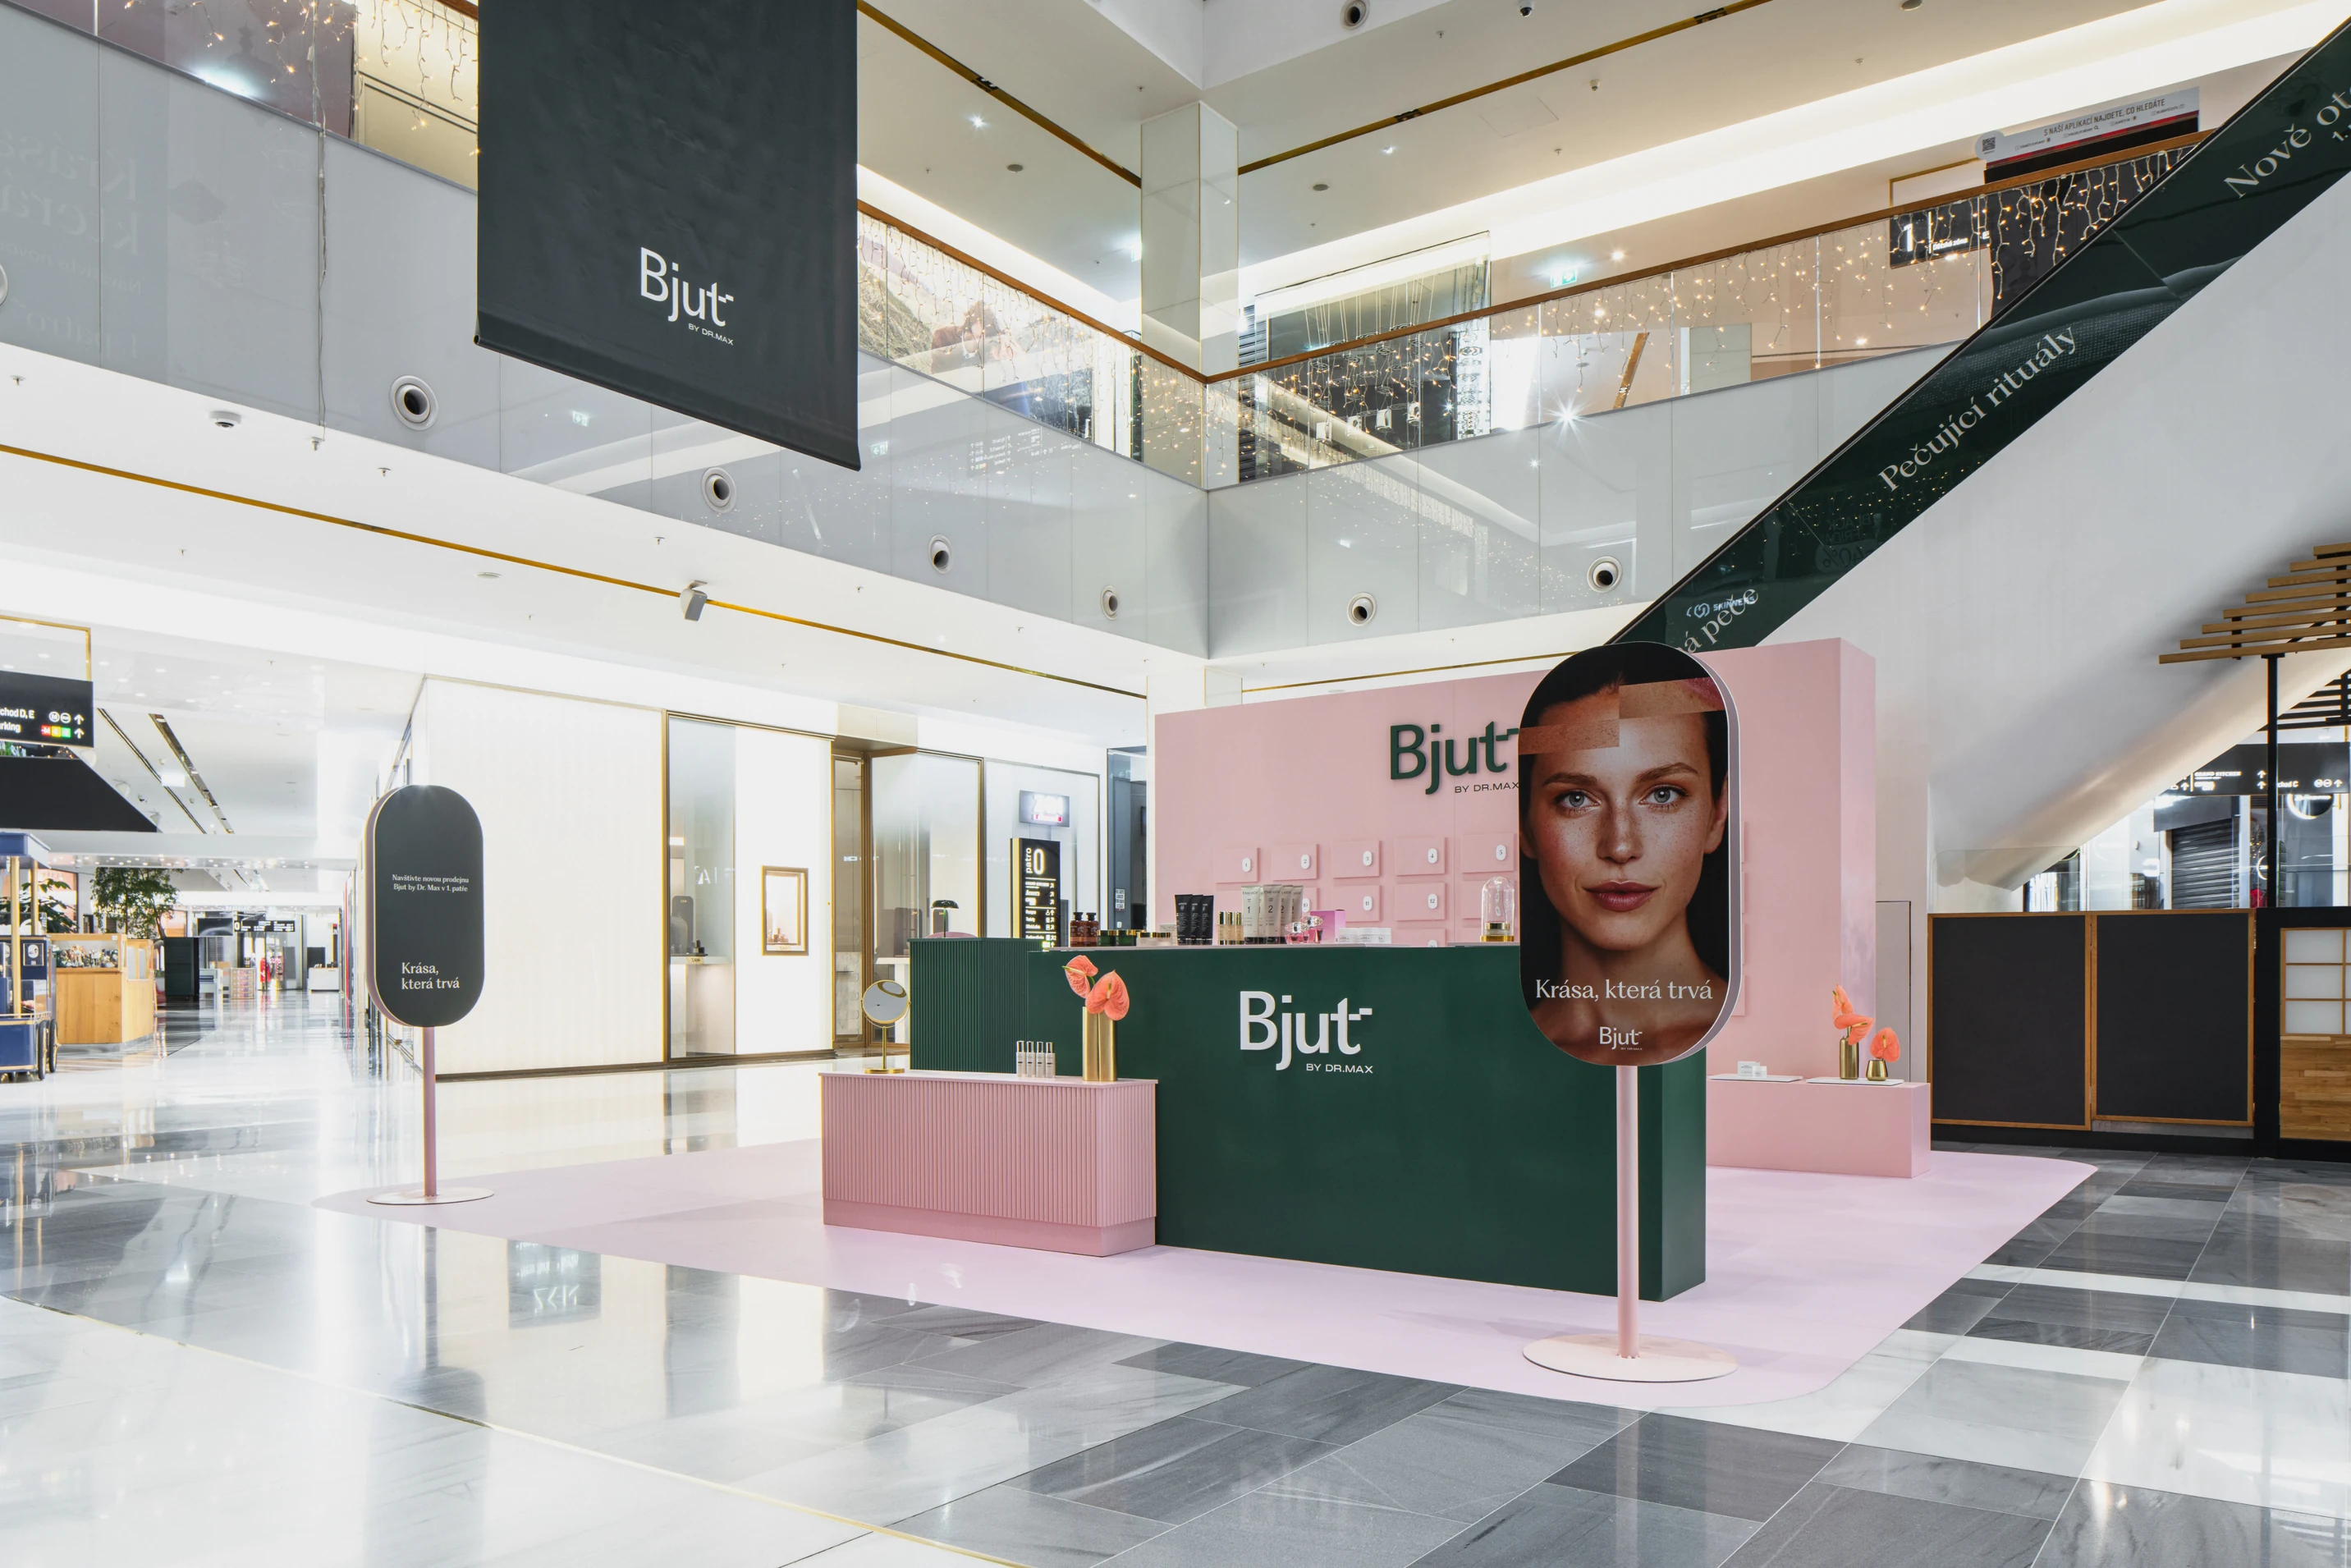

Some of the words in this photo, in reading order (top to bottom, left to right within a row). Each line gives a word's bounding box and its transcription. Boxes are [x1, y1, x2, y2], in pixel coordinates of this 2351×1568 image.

[2049, 124, 2064, 135] NAŠÍ
[2065, 116, 2092, 131] APLIKACÍ
[2093, 110, 2124, 123] NAJDETE,
[2126, 106, 2134, 116] CO
[2136, 99, 2165, 112] HLEDÁTE
[2223, 123, 2312, 199] Nově
[2317, 86, 2351, 126] ot
[1904, 223, 1913, 252] 1
[640, 246, 734, 327] Bjut
[688, 323, 699, 332] BY
[702, 328, 734, 346] DR.MAX
[1877, 396, 1987, 492] Pečující
[1986, 327, 2076, 407] rituály
[28, 709, 35, 719] E
[1390, 721, 1519, 795] Bjut
[1455, 785, 1469, 793] BY
[1473, 782, 1519, 792] DR.MAX
[1024, 847, 1033, 874] patro
[1033, 848, 1045, 875] 0
[392, 873, 421, 882] Navštivte
[442, 876, 470, 884] prodejnu
[393, 883, 407, 892] Bjut
[408, 883, 415, 892] by
[451, 885, 469, 893] patře
[1267, 905, 1273, 914] 2
[401, 961, 439, 976] Krása,
[401, 977, 433, 990] která
[436, 976, 460, 989] trvá
[1536, 979, 1599, 1002] Krása,
[1605, 979, 1662, 999] která
[1667, 979, 1713, 999] trvá
[1240, 990, 1373, 1071] Bjut
[1599, 1026, 1643, 1050] Bjut
[1306, 1063, 1322, 1072] BY
[1325, 1064, 1373, 1074] DR.MAX
